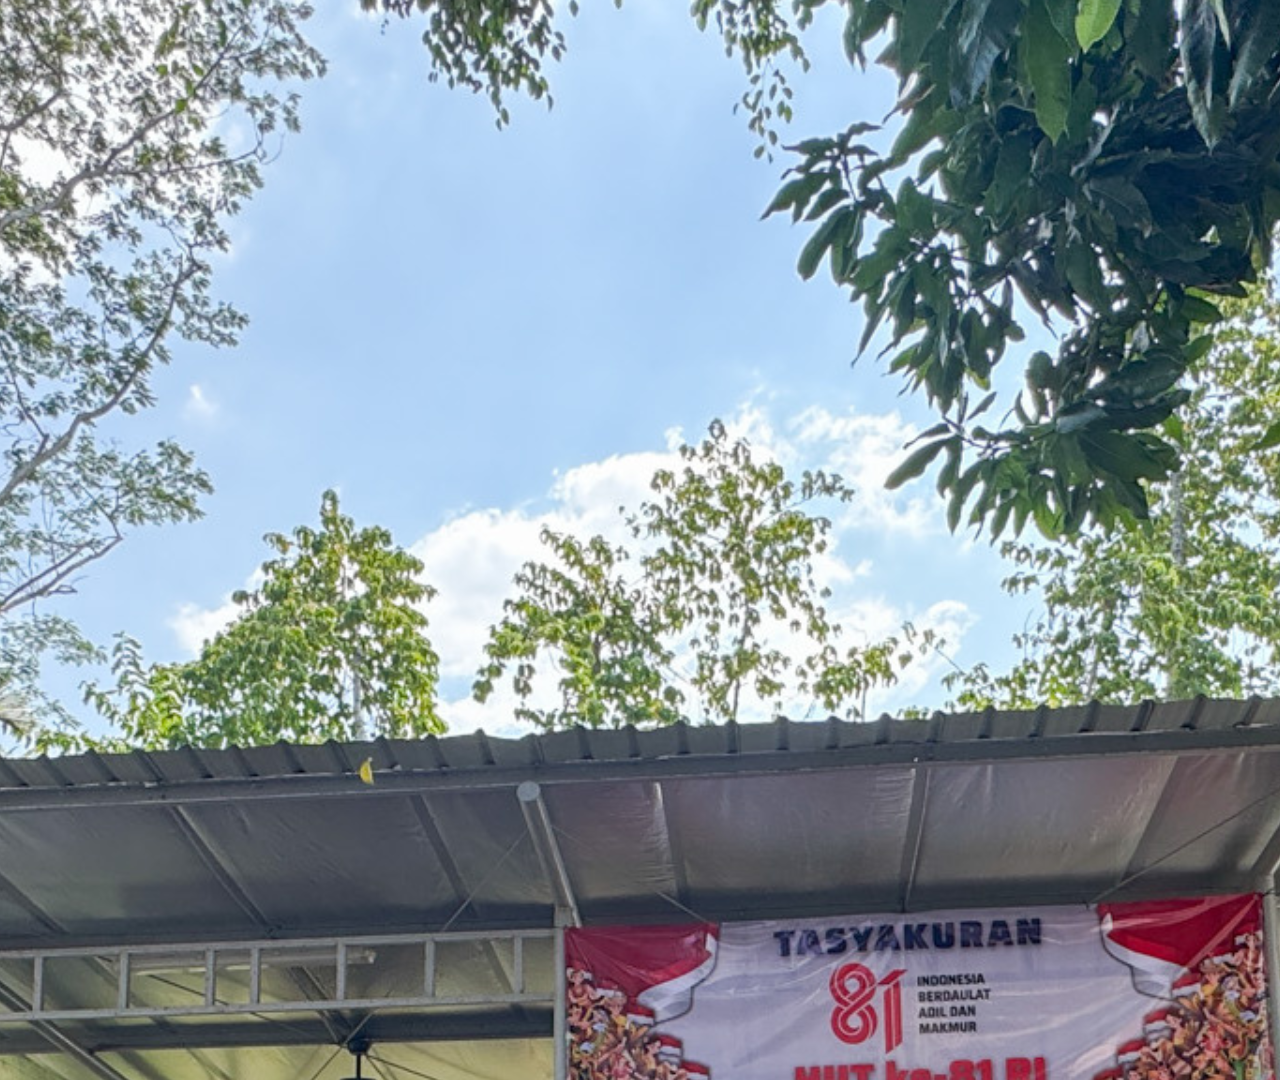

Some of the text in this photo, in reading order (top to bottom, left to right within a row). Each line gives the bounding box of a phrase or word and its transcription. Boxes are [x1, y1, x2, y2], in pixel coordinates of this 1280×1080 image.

[773, 918, 1042, 957] TASYAKURAN
[917, 973, 985, 986] INDONESIA
[918, 988, 991, 1002] BERDAULAT
[829, 962, 908, 1053] 81
[919, 1005, 976, 1018] ADIL DAN
[919, 1021, 977, 1034] MAKMUR
